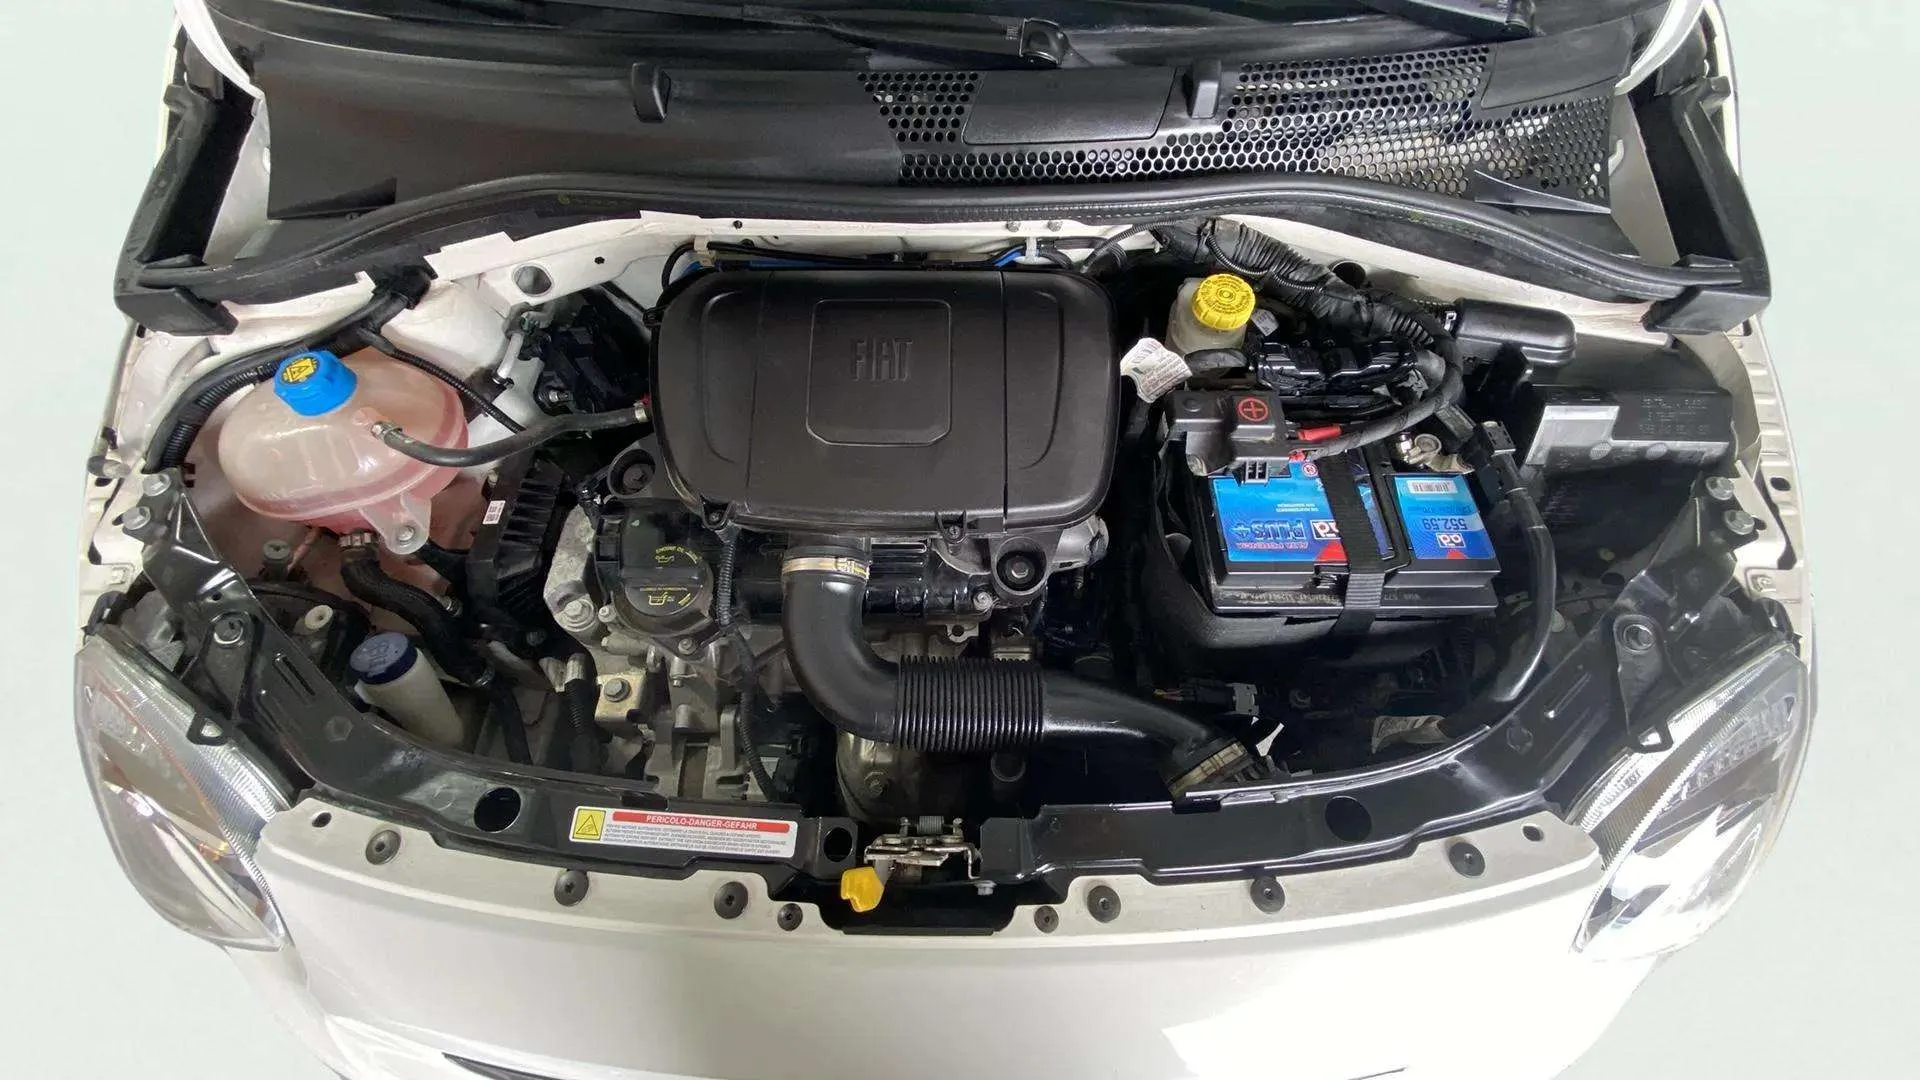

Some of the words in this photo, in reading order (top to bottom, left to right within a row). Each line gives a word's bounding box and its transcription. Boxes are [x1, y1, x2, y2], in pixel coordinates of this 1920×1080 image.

[849, 337, 913, 381] FIAT
[1422, 518, 1467, 531] 552.59
[645, 814, 758, 831] PERICOLO-DANGER-GEFAHR
